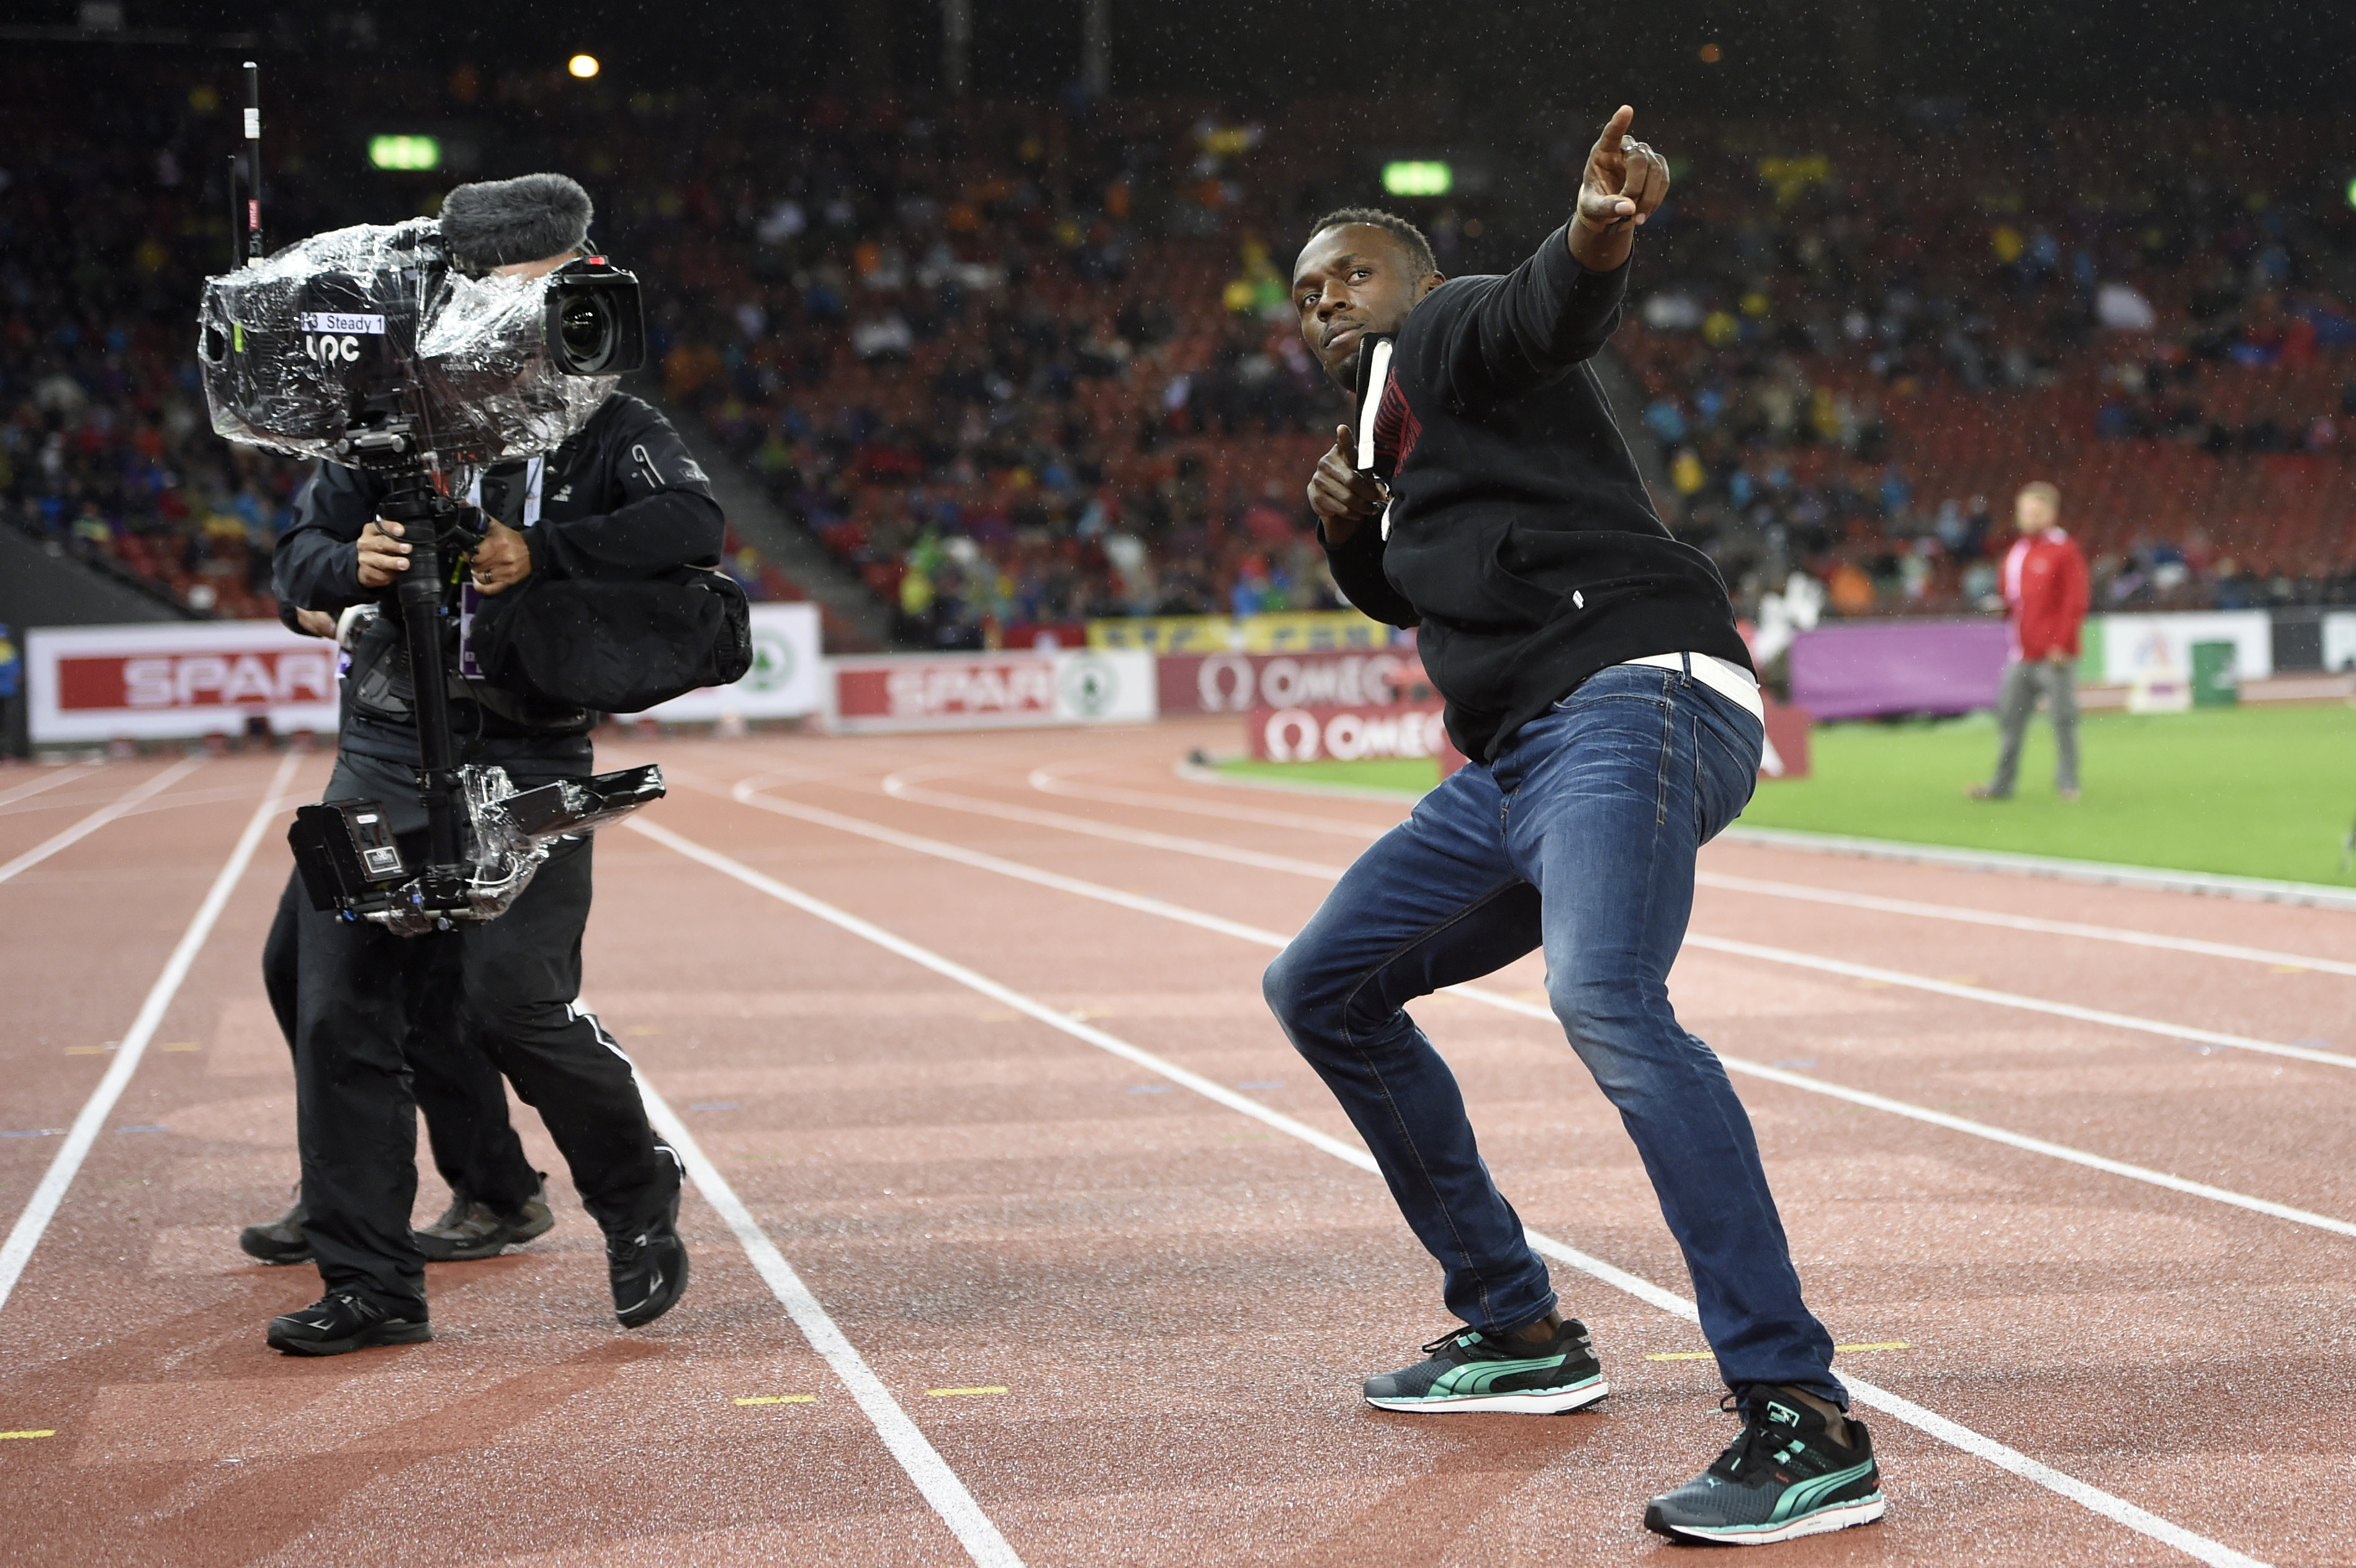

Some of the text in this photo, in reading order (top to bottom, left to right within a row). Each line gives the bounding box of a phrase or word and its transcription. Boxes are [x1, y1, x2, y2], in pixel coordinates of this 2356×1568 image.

[327, 315, 371, 333] Steady
[377, 317, 382, 331] 1
[124, 653, 332, 706] SPAR
[886, 665, 1050, 715] SPAR
[1260, 654, 1404, 709] OMEG
[1324, 711, 1447, 761] OME
